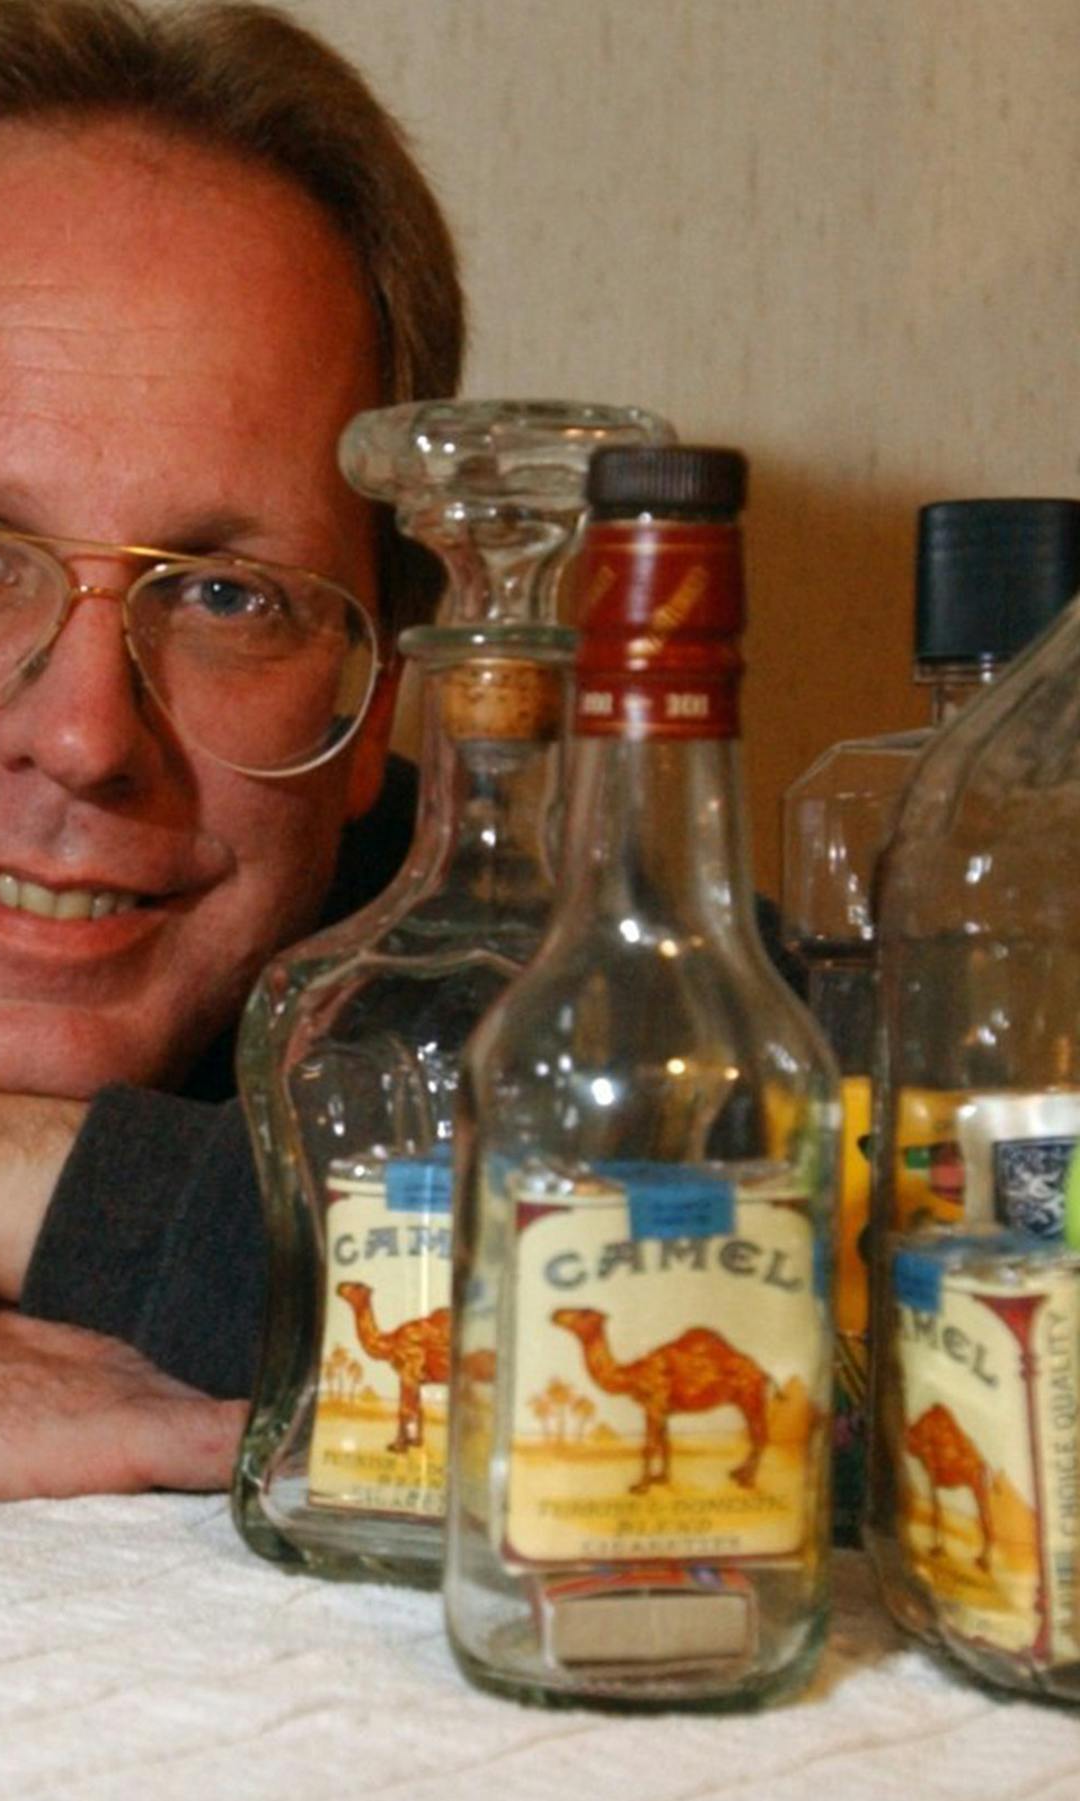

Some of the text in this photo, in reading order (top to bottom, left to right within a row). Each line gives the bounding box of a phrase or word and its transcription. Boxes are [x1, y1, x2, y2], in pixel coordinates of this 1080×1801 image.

[334, 1226, 450, 1266] CAM
[544, 1239, 803, 1291] CAMEL
[908, 1308, 998, 1388] MEL
[1047, 1311, 1077, 1430] QUALITY
